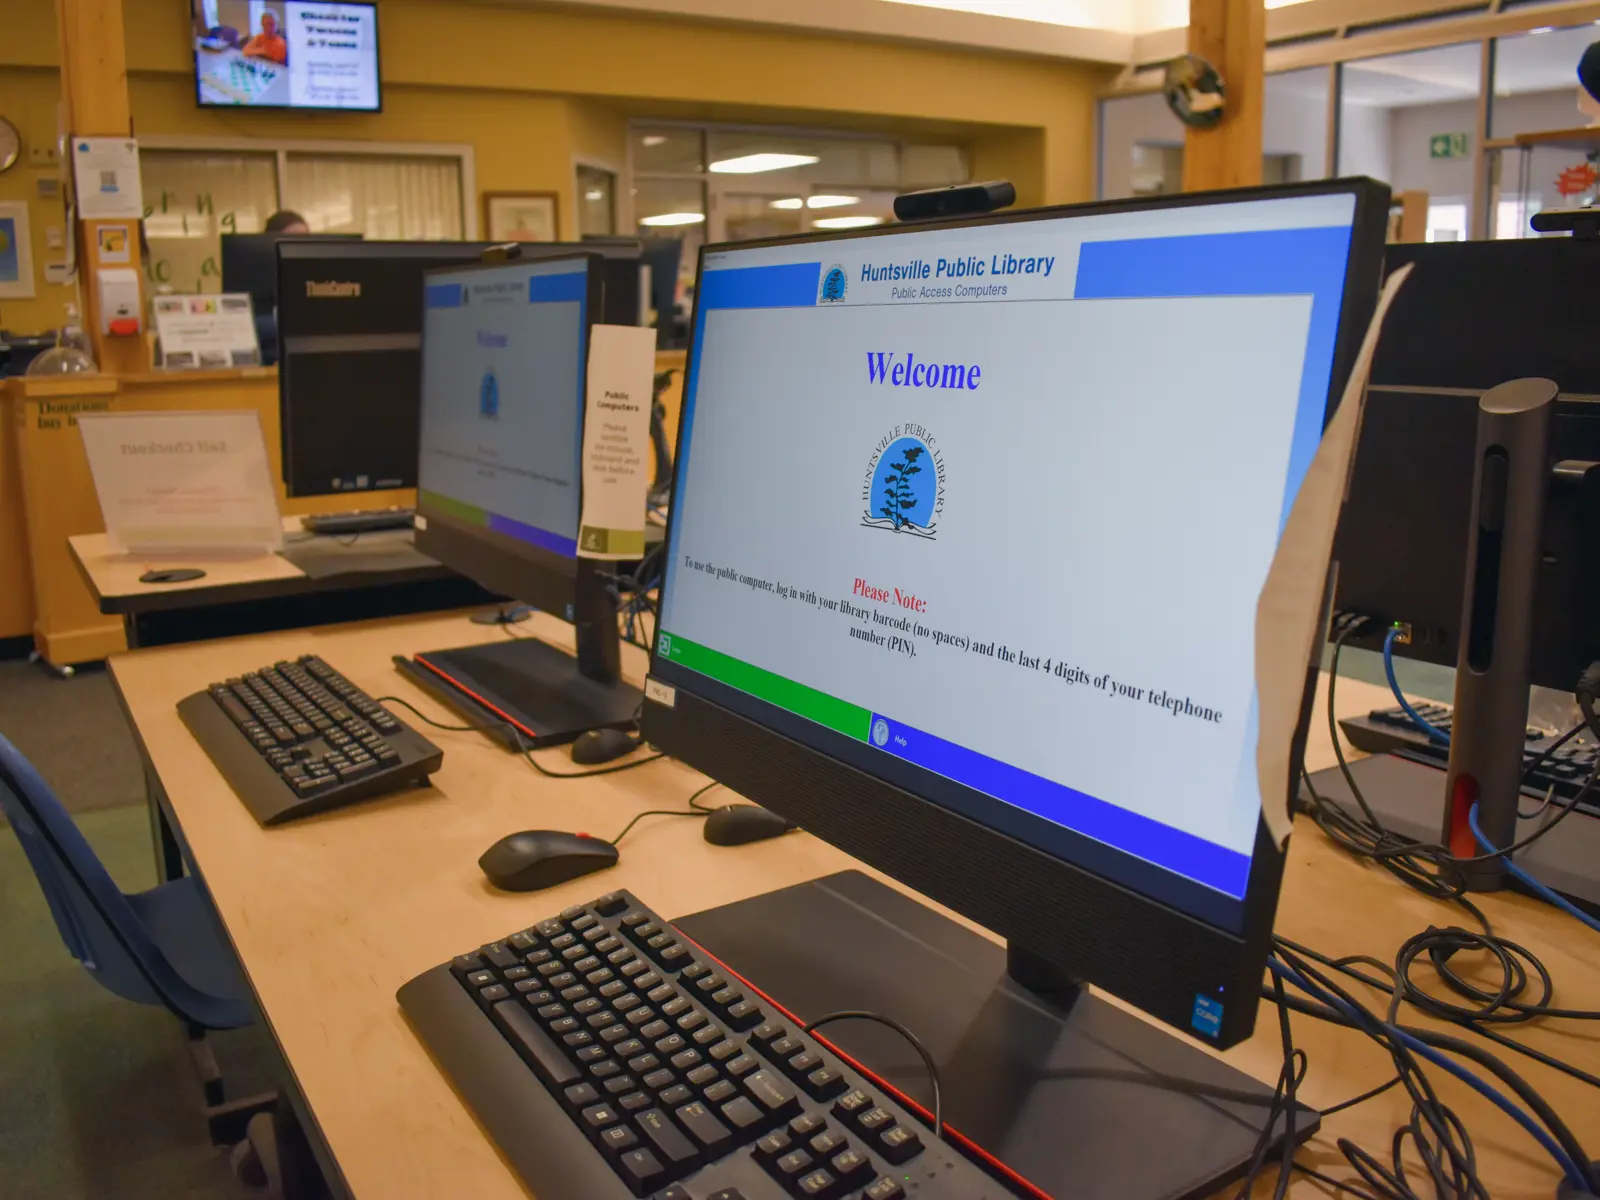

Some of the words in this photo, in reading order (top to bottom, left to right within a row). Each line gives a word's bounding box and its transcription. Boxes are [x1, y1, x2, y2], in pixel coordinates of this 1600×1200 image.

[861, 260, 931, 282] Huntsville
[935, 256, 985, 280] Public
[990, 254, 1055, 277] Library
[891, 286, 917, 299] Public
[919, 285, 952, 298] Access
[955, 283, 1008, 299] Computers
[866, 352, 981, 390] Welcome
[597, 401, 640, 413] Computers
[604, 391, 630, 401] Public
[862, 425, 901, 500] HUNTSVILLE
[904, 423, 936, 448] PUBLIC
[934, 449, 946, 518] LIBRARY
[852, 577, 890, 603] Please
[892, 587, 927, 613] Note:
[685, 555, 694, 568] To
[694, 560, 705, 572] use
[705, 562, 716, 576] the
[716, 565, 738, 582] public
[739, 572, 775, 594] computer,
[776, 581, 788, 599] log
[789, 585, 797, 599] in
[799, 588, 817, 605] with
[818, 597, 839, 612] your
[839, 600, 871, 624] library
[872, 606, 911, 632] barcode
[912, 621, 930, 638] (no
[932, 625, 970, 652] spaces)
[972, 640, 995, 657] and
[997, 645, 1016, 663] the
[1018, 650, 1041, 671] last
[1043, 658, 1052, 673] 4
[1054, 661, 1090, 685] digits
[1093, 674, 1110, 690] of
[1111, 679, 1145, 700] your
[1148, 688, 1223, 723] telephone
[849, 625, 886, 647] number
[887, 634, 917, 657] (PIN).
[894, 734, 908, 747] Help
